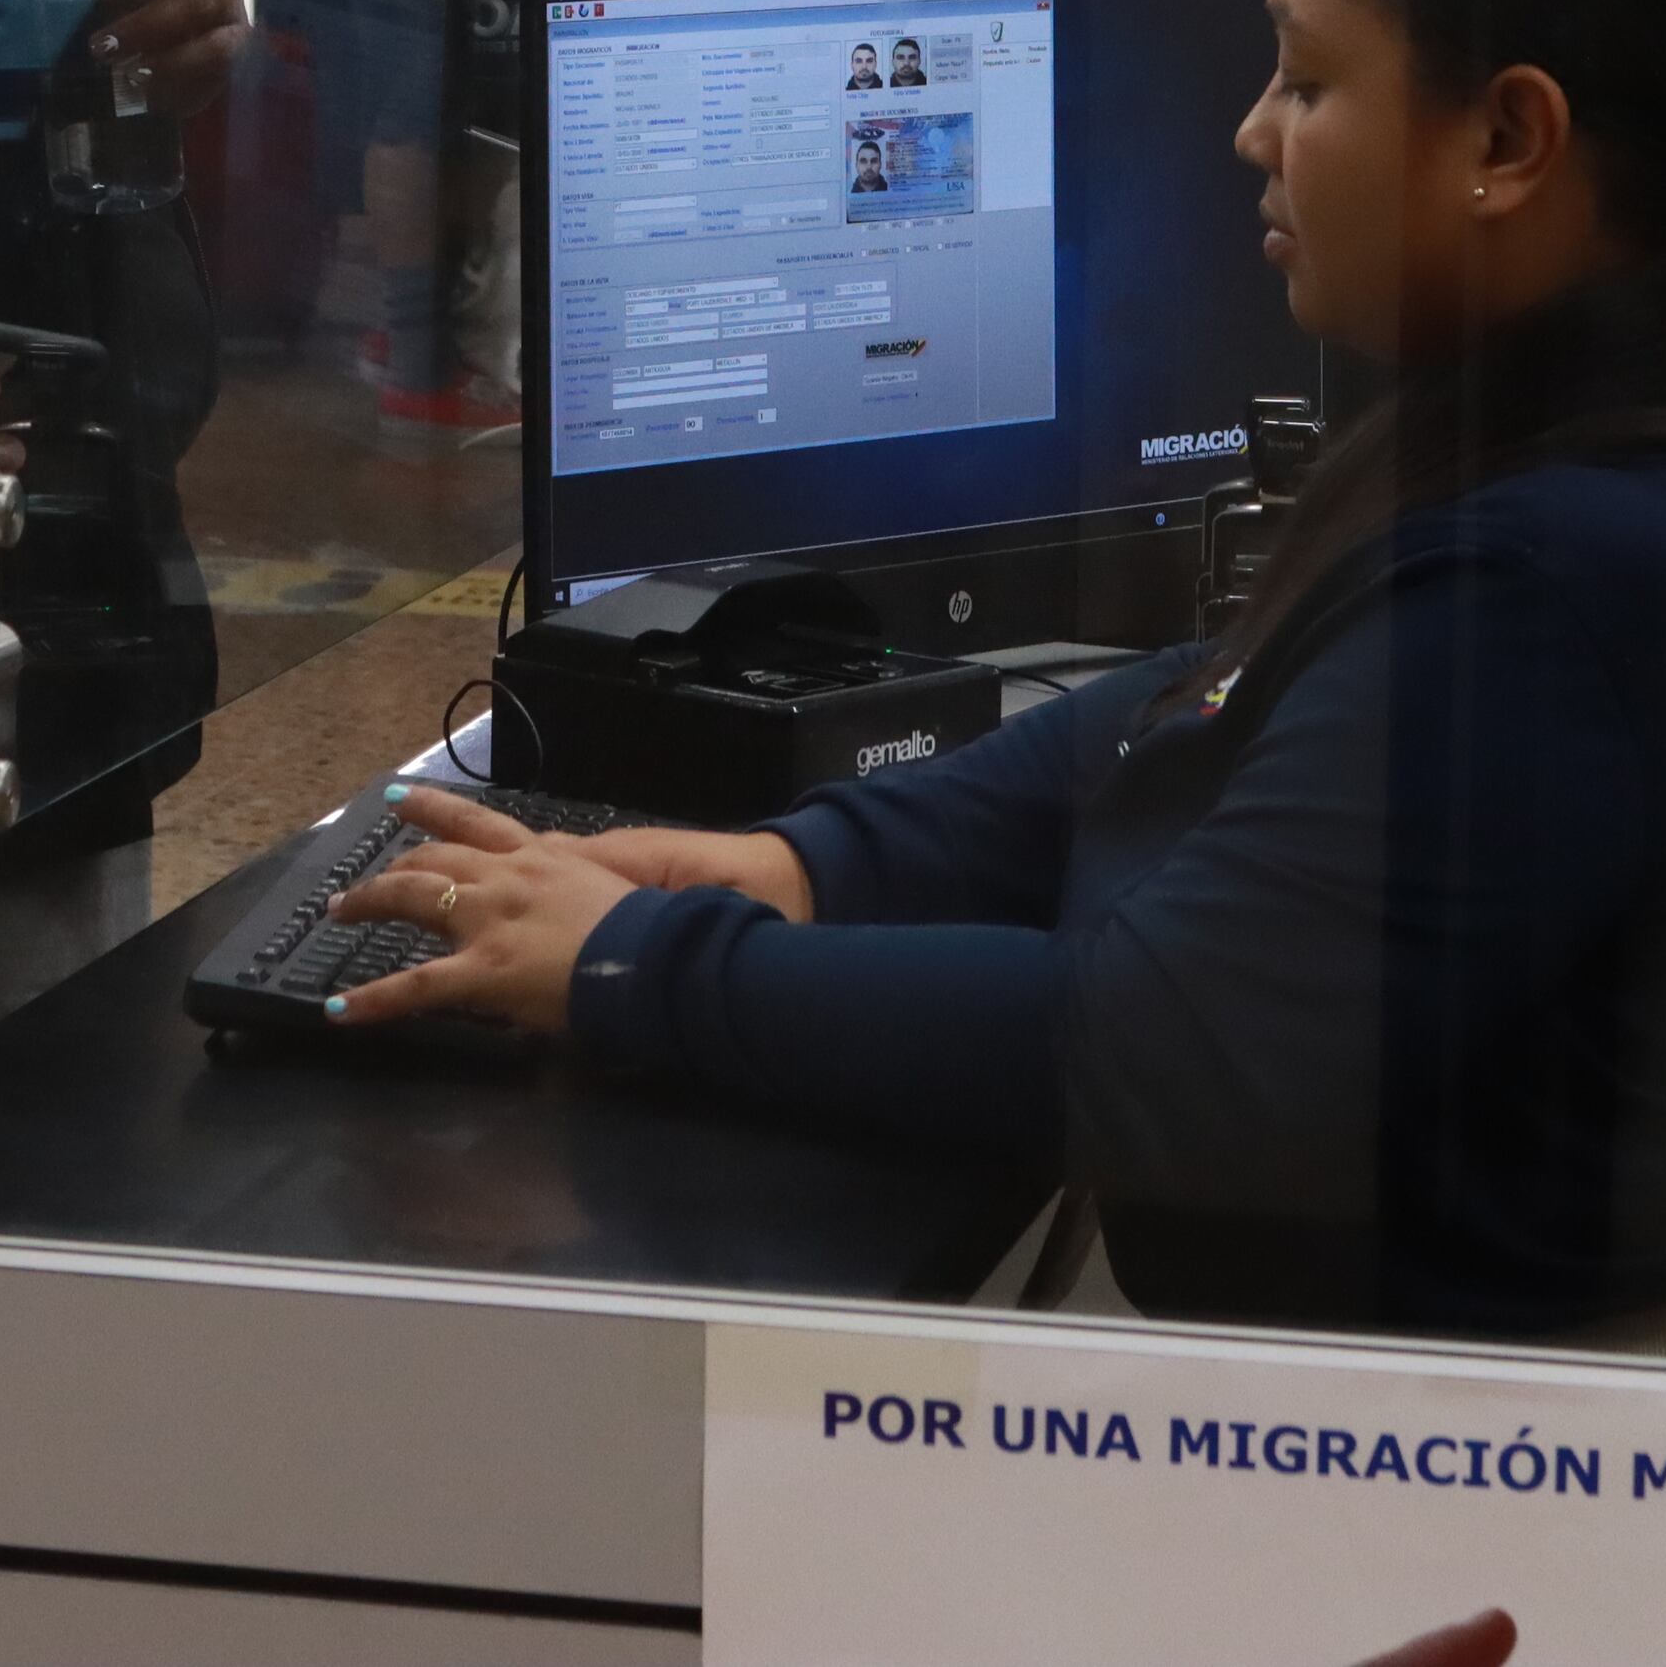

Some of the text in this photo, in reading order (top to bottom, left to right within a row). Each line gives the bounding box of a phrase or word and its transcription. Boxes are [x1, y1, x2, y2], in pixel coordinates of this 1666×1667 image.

[946, 181, 966, 192] USA
[865, 338, 920, 356] MIGRACIÓN
[950, 592, 971, 624] hp
[857, 730, 936, 777] gemalto
[823, 1390, 966, 1449] POR
[992, 1403, 1142, 1463] UNA
[1169, 1417, 1601, 1497] MIGRACIÓN
